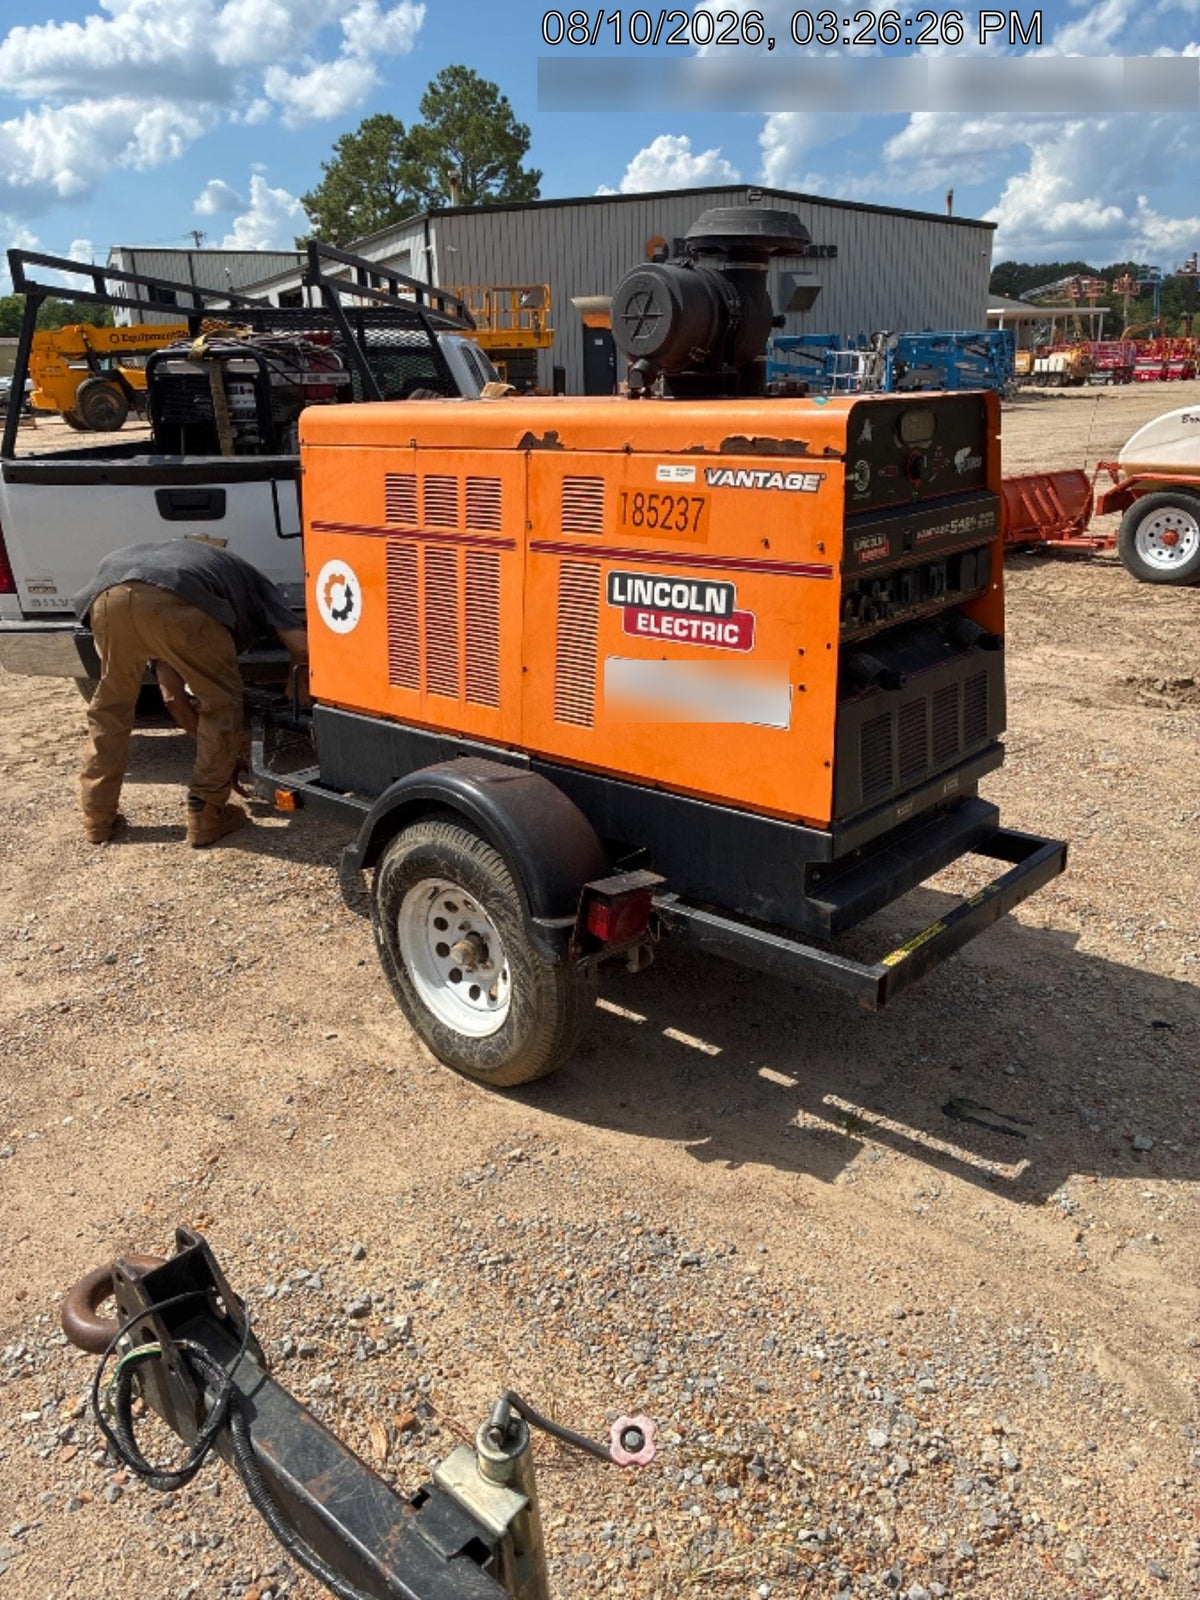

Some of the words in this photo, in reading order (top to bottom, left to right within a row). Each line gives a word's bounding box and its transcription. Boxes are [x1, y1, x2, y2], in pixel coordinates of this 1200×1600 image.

[705, 468, 821, 493] VANTAGE
[620, 492, 706, 533] 185237
[612, 577, 727, 614] LINCOLN
[636, 613, 740, 644] ELECTRIC
